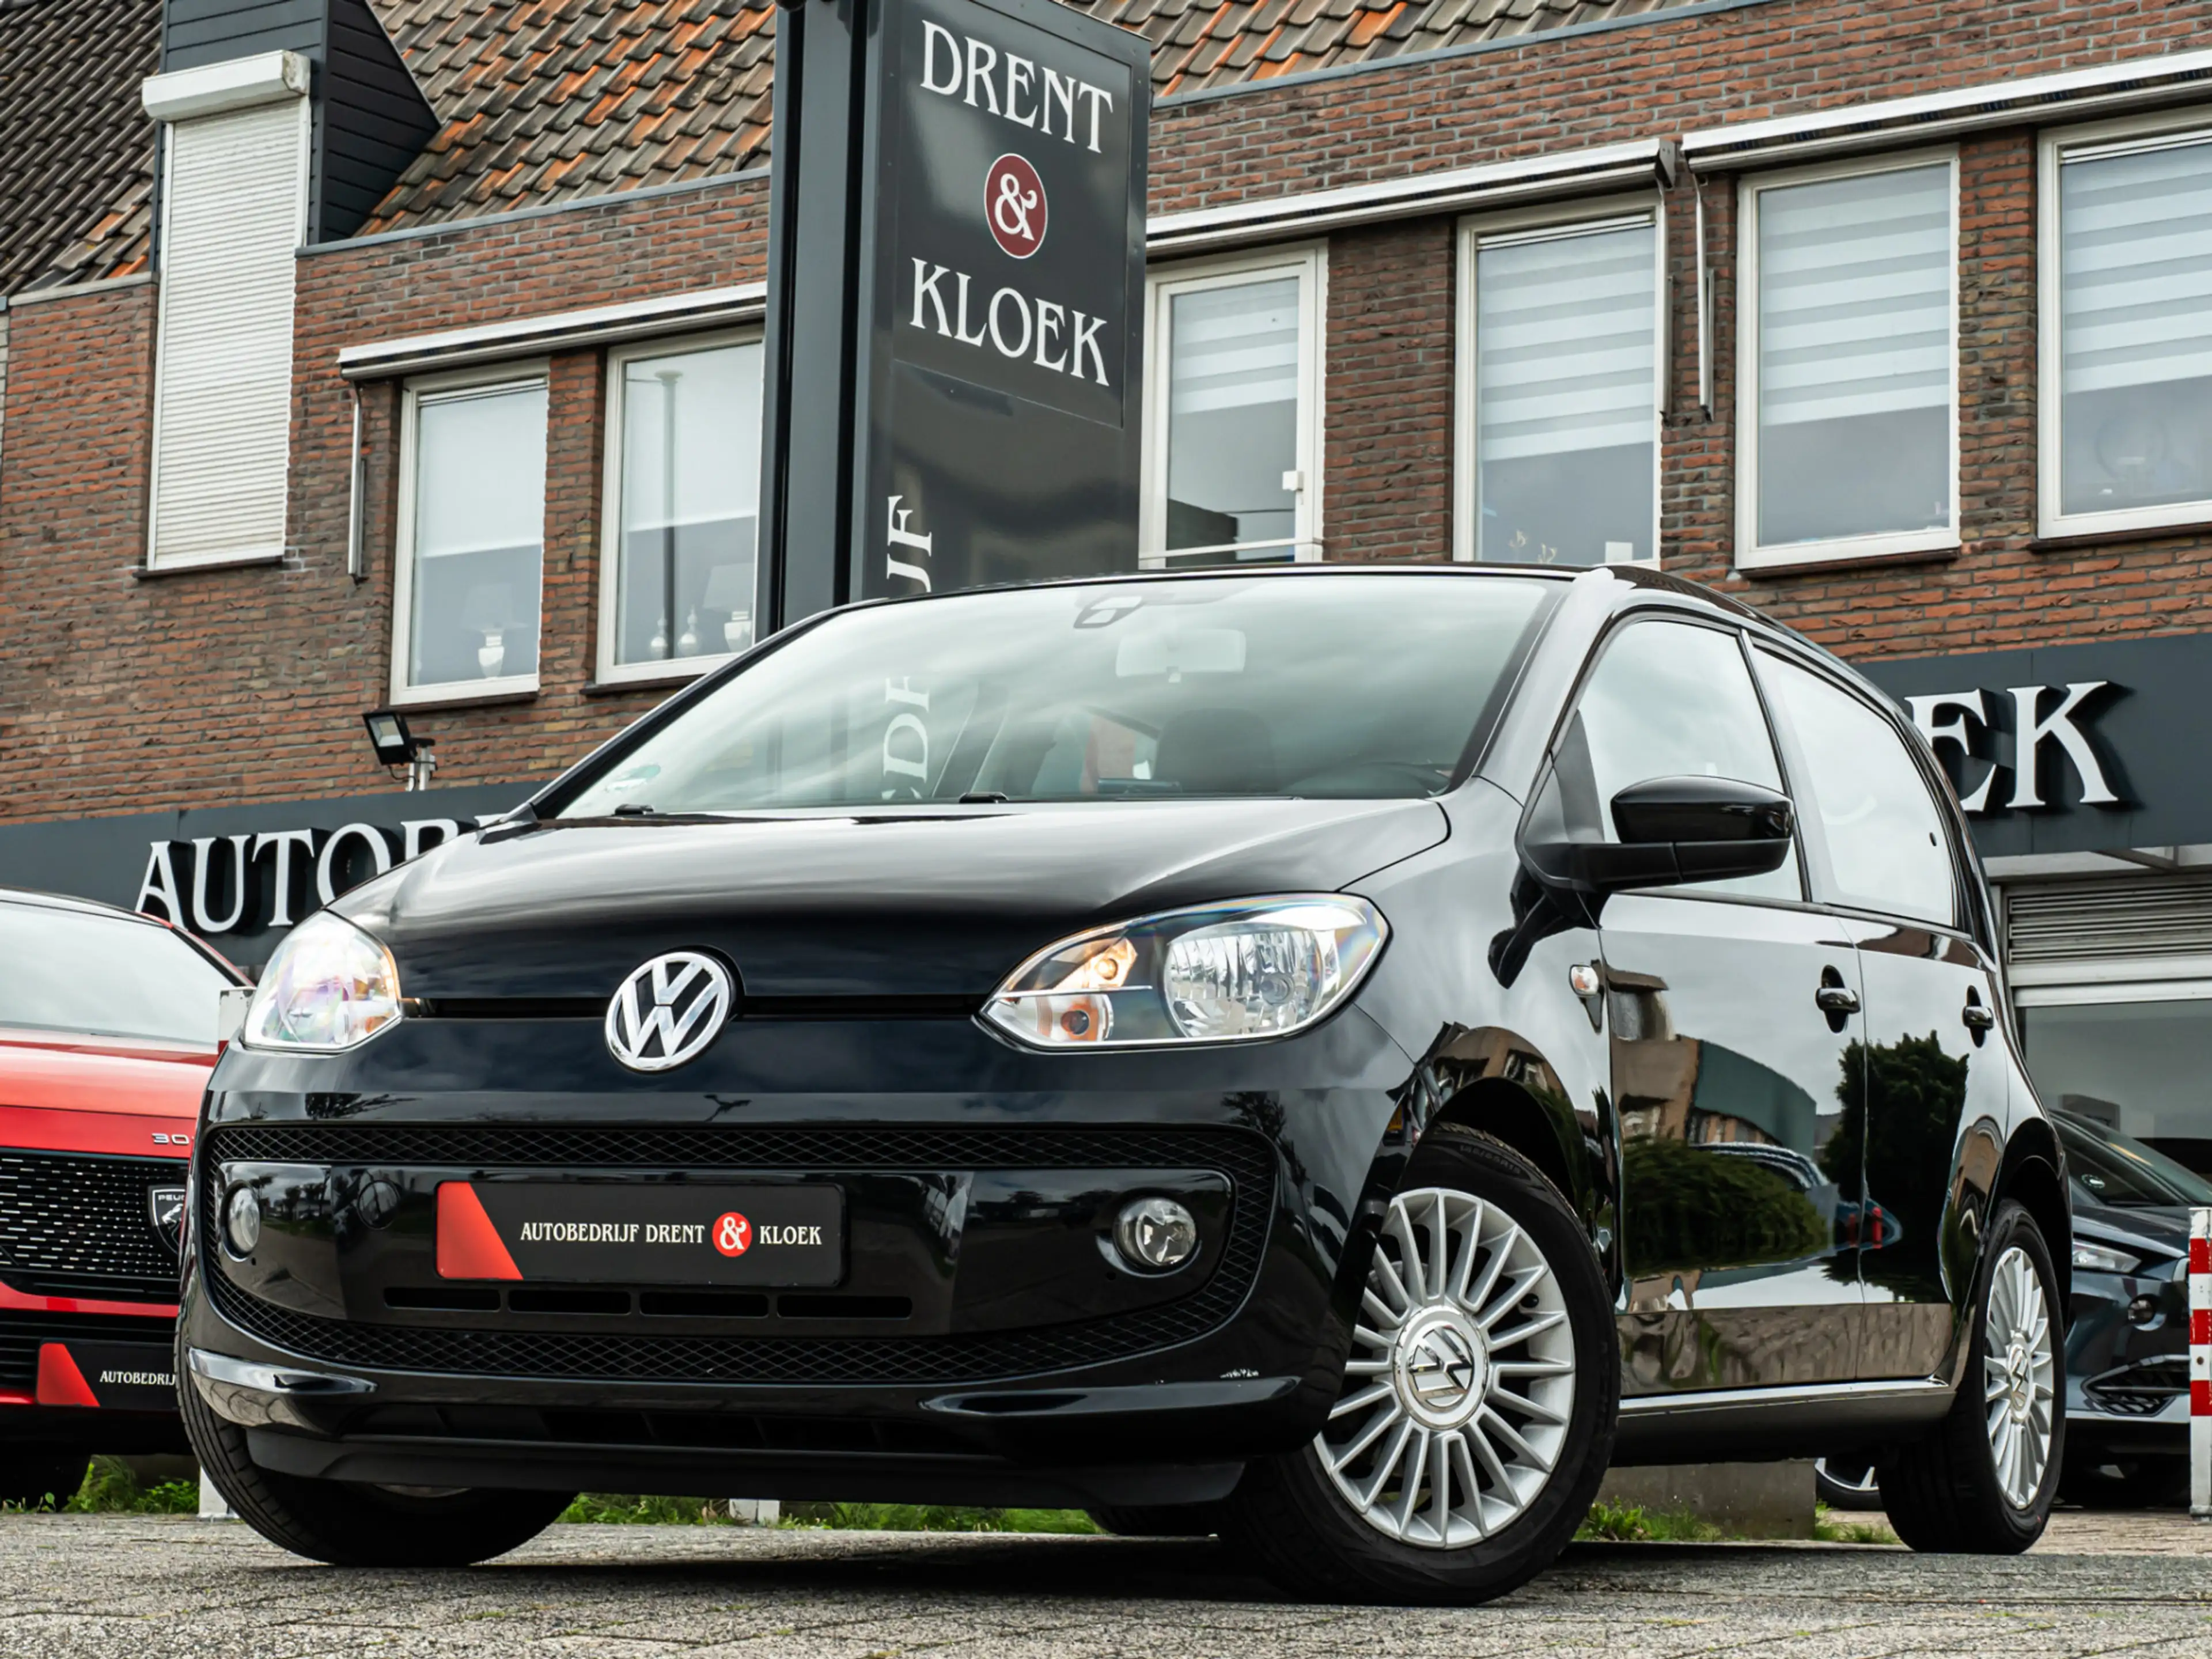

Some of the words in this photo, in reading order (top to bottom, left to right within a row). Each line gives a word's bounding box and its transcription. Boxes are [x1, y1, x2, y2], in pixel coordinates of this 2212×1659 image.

[921, 20, 1113, 153] DRENT
[995, 173, 1037, 241] &
[910, 257, 1109, 387] KLOEK
[151, 1133, 195, 1145] 30
[520, 1222, 640, 1243] AUTOBEDRIJF
[646, 1224, 705, 1244] DRENT
[719, 1217, 747, 1249] &
[759, 1225, 822, 1245] KLOEK
